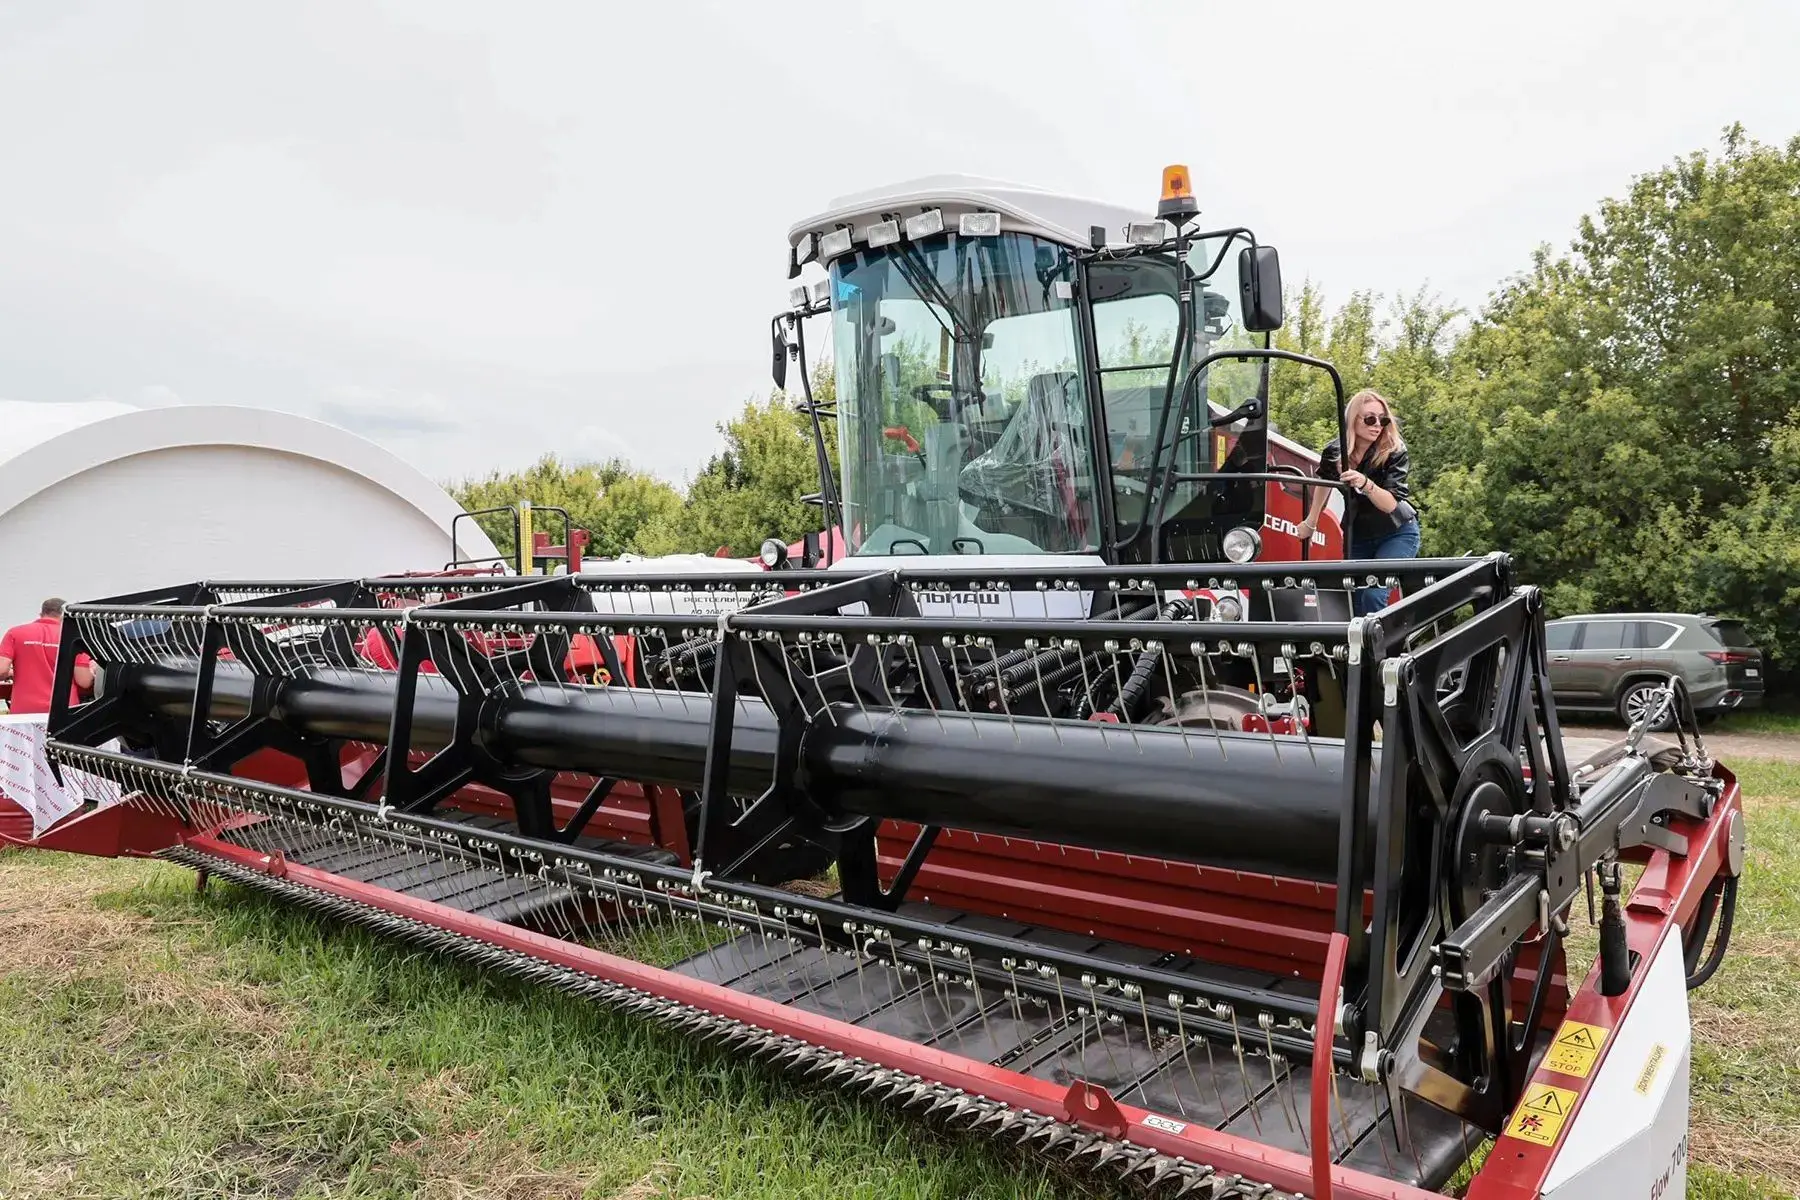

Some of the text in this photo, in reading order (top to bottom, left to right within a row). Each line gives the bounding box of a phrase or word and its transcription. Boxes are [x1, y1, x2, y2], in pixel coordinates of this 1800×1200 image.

[1550, 1060, 1581, 1073] STOP
[1637, 1045, 1666, 1093] ДОКУМЕНТАЦИЯ
[1650, 1134, 1687, 1200] Flow 700
